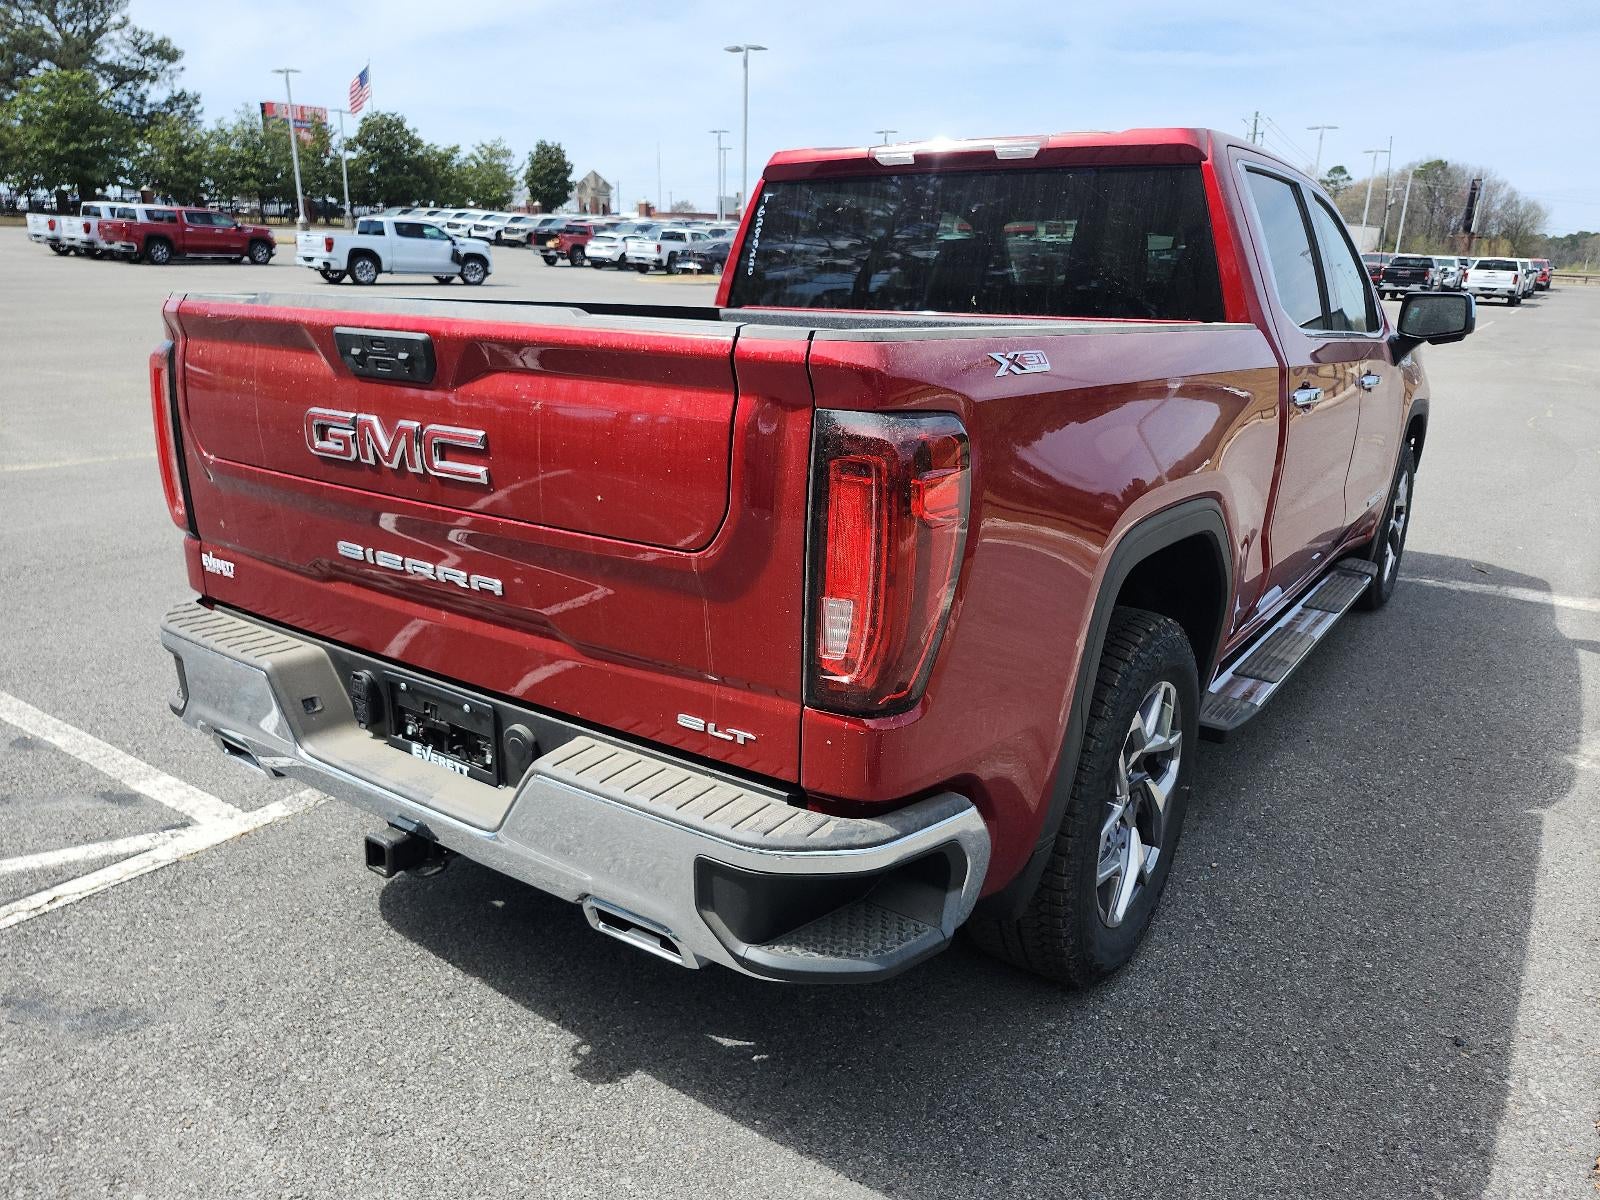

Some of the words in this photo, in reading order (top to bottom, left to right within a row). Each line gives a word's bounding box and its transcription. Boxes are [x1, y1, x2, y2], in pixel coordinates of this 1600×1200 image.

[304, 406, 488, 485] GMC
[336, 540, 504, 596] SIERRA
[677, 713, 757, 745] SLT
[411, 741, 470, 777] EVERETT
